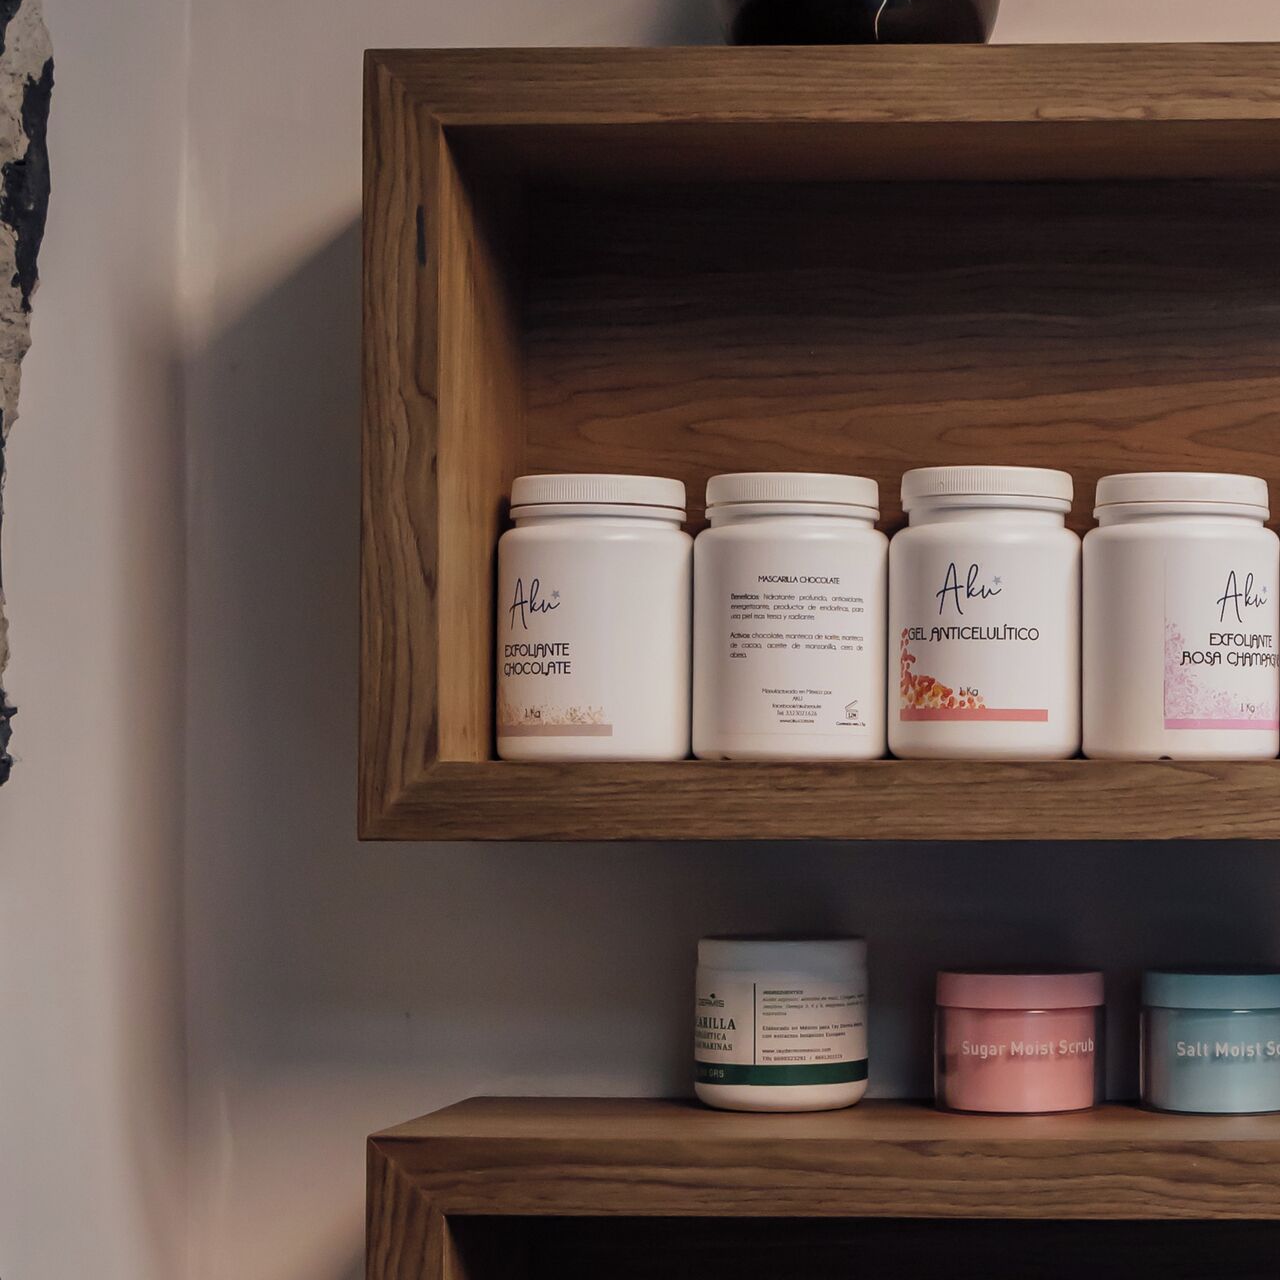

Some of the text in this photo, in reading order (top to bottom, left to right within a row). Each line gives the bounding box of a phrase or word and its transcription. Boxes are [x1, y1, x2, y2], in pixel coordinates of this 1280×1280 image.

[758, 575, 840, 585] MASCARILLA CHOCOLATE
[936, 563, 1002, 615] Aku
[1217, 570, 1268, 623] Aku
[908, 624, 1040, 642] GEL ANTICELULÍTICO
[1210, 633, 1272, 649] EXFOLIANTE
[504, 643, 570, 658] EXFOLIANTE
[1180, 651, 1221, 666] ROSA
[504, 661, 572, 677] CHOCOLATE
[961, 1039, 1095, 1059] Sugar Moist Scrub
[1176, 1040, 1209, 1057] Salt
[1215, 1041, 1262, 1057] Moist
